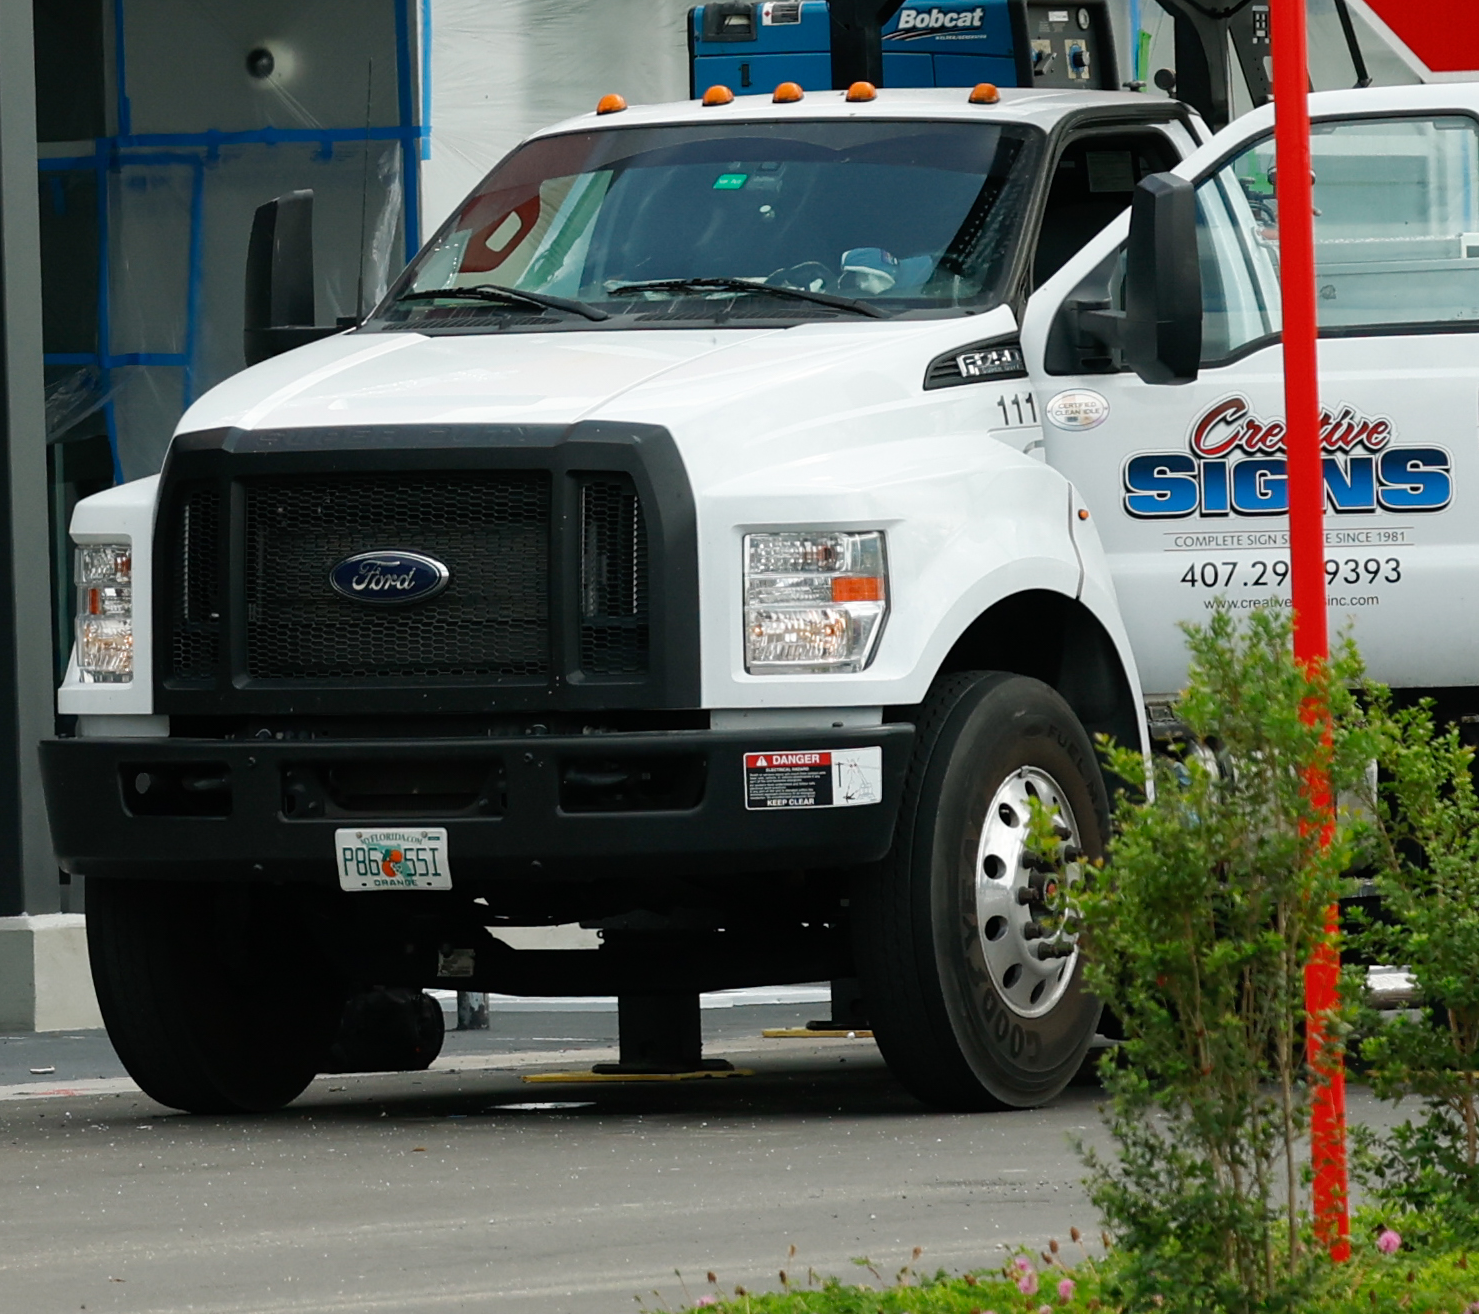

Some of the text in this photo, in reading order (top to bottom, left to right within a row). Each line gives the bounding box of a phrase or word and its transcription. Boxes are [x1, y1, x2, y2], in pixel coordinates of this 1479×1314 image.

[898, 7, 984, 29] Bobcat
[997, 392, 1037, 426] 111
[1124, 446, 1453, 518] SIGNS
[1174, 534, 1243, 548] COMPLETE
[1247, 533, 1278, 547] SIGN
[1336, 532, 1372, 544] SINCE
[1376, 530, 1406, 543] 1981
[352, 559, 417, 591] Ford
[1180, 557, 1403, 588] 407.299393
[772, 754, 820, 766] DANGER
[766, 798, 815, 807] KEEP CLEAR
[342, 847, 381, 877] P86
[374, 879, 418, 887] ORANGE
